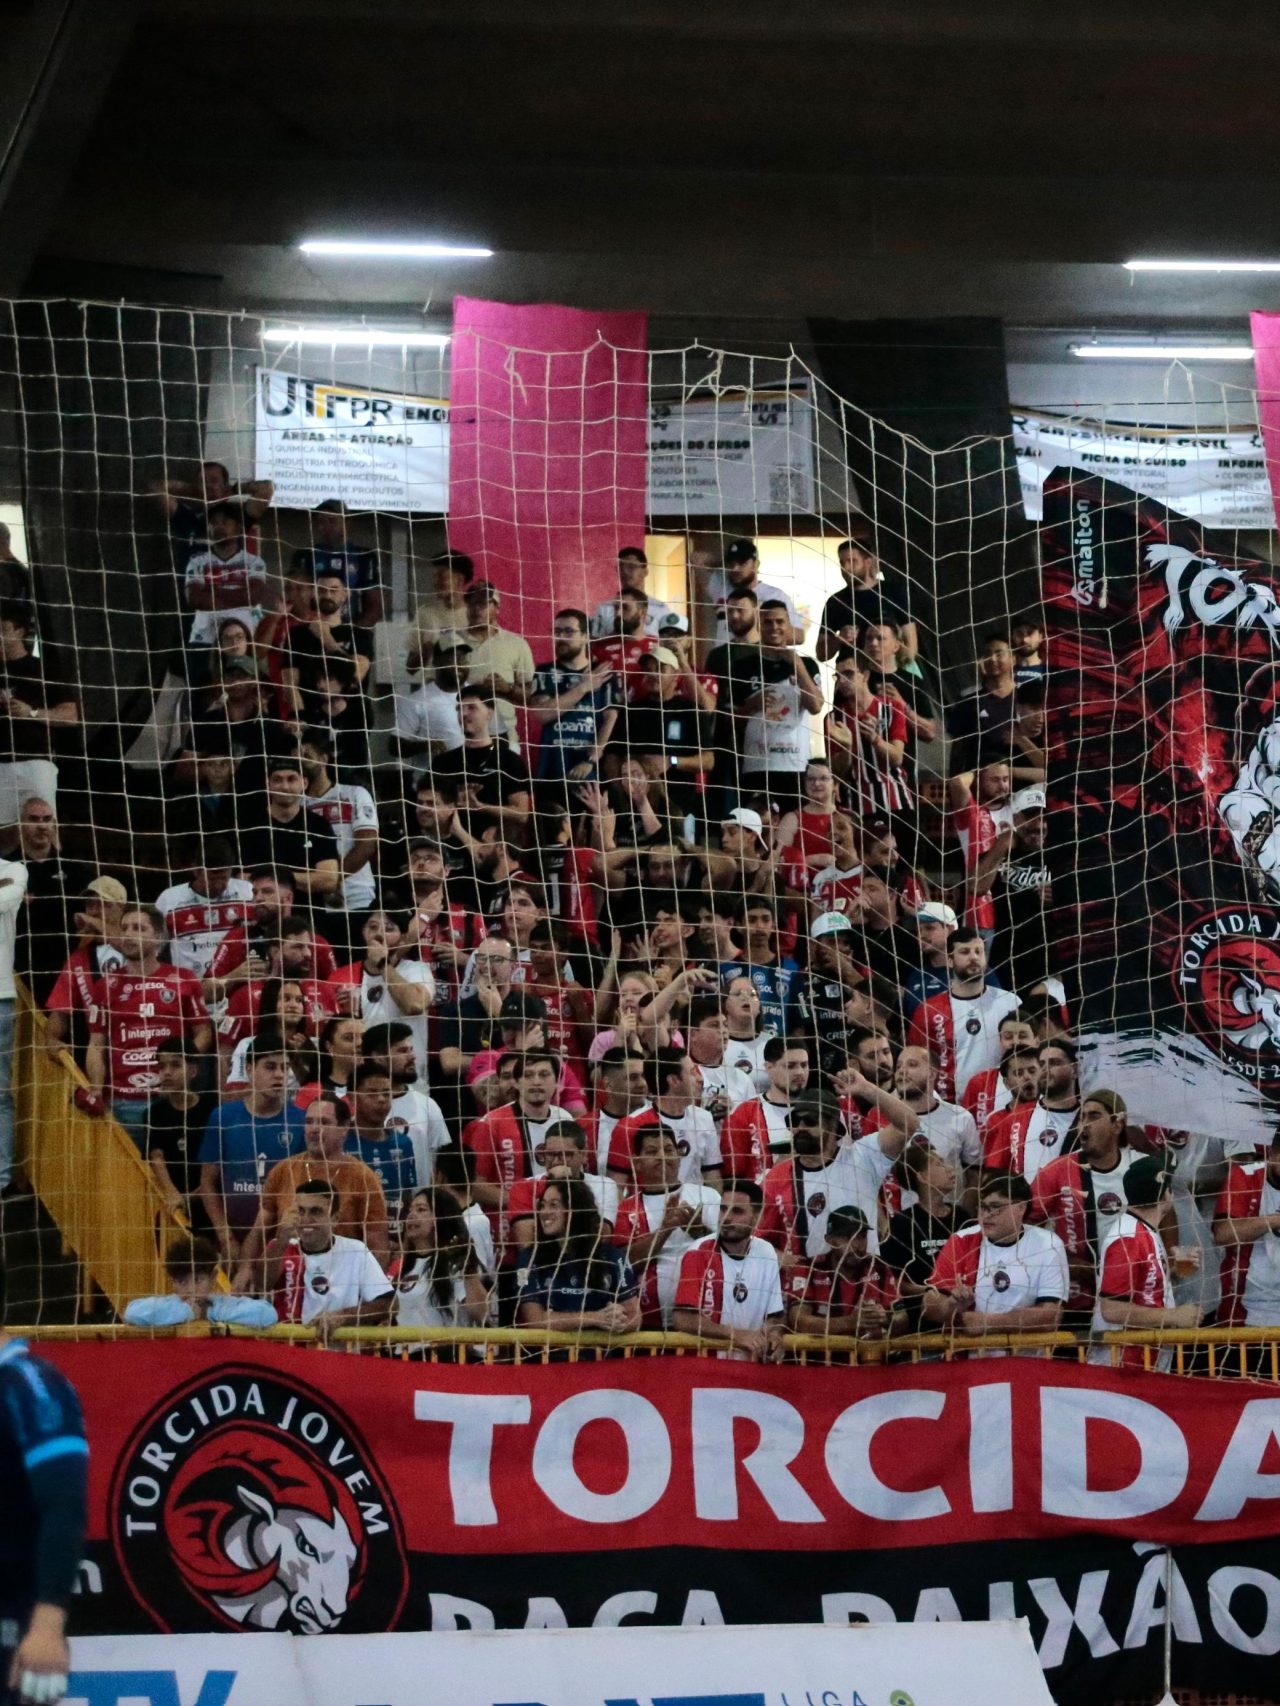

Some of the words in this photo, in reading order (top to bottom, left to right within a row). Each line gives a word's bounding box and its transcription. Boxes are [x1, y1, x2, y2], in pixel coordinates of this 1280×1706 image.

[350, 432, 413, 447] ATUAÇÃO
[1074, 499, 1094, 579] maiton
[1180, 914, 1262, 986] TORCIDA
[125, 1382, 266, 1537] TORCIDA
[277, 1396, 389, 1536] JOVEM
